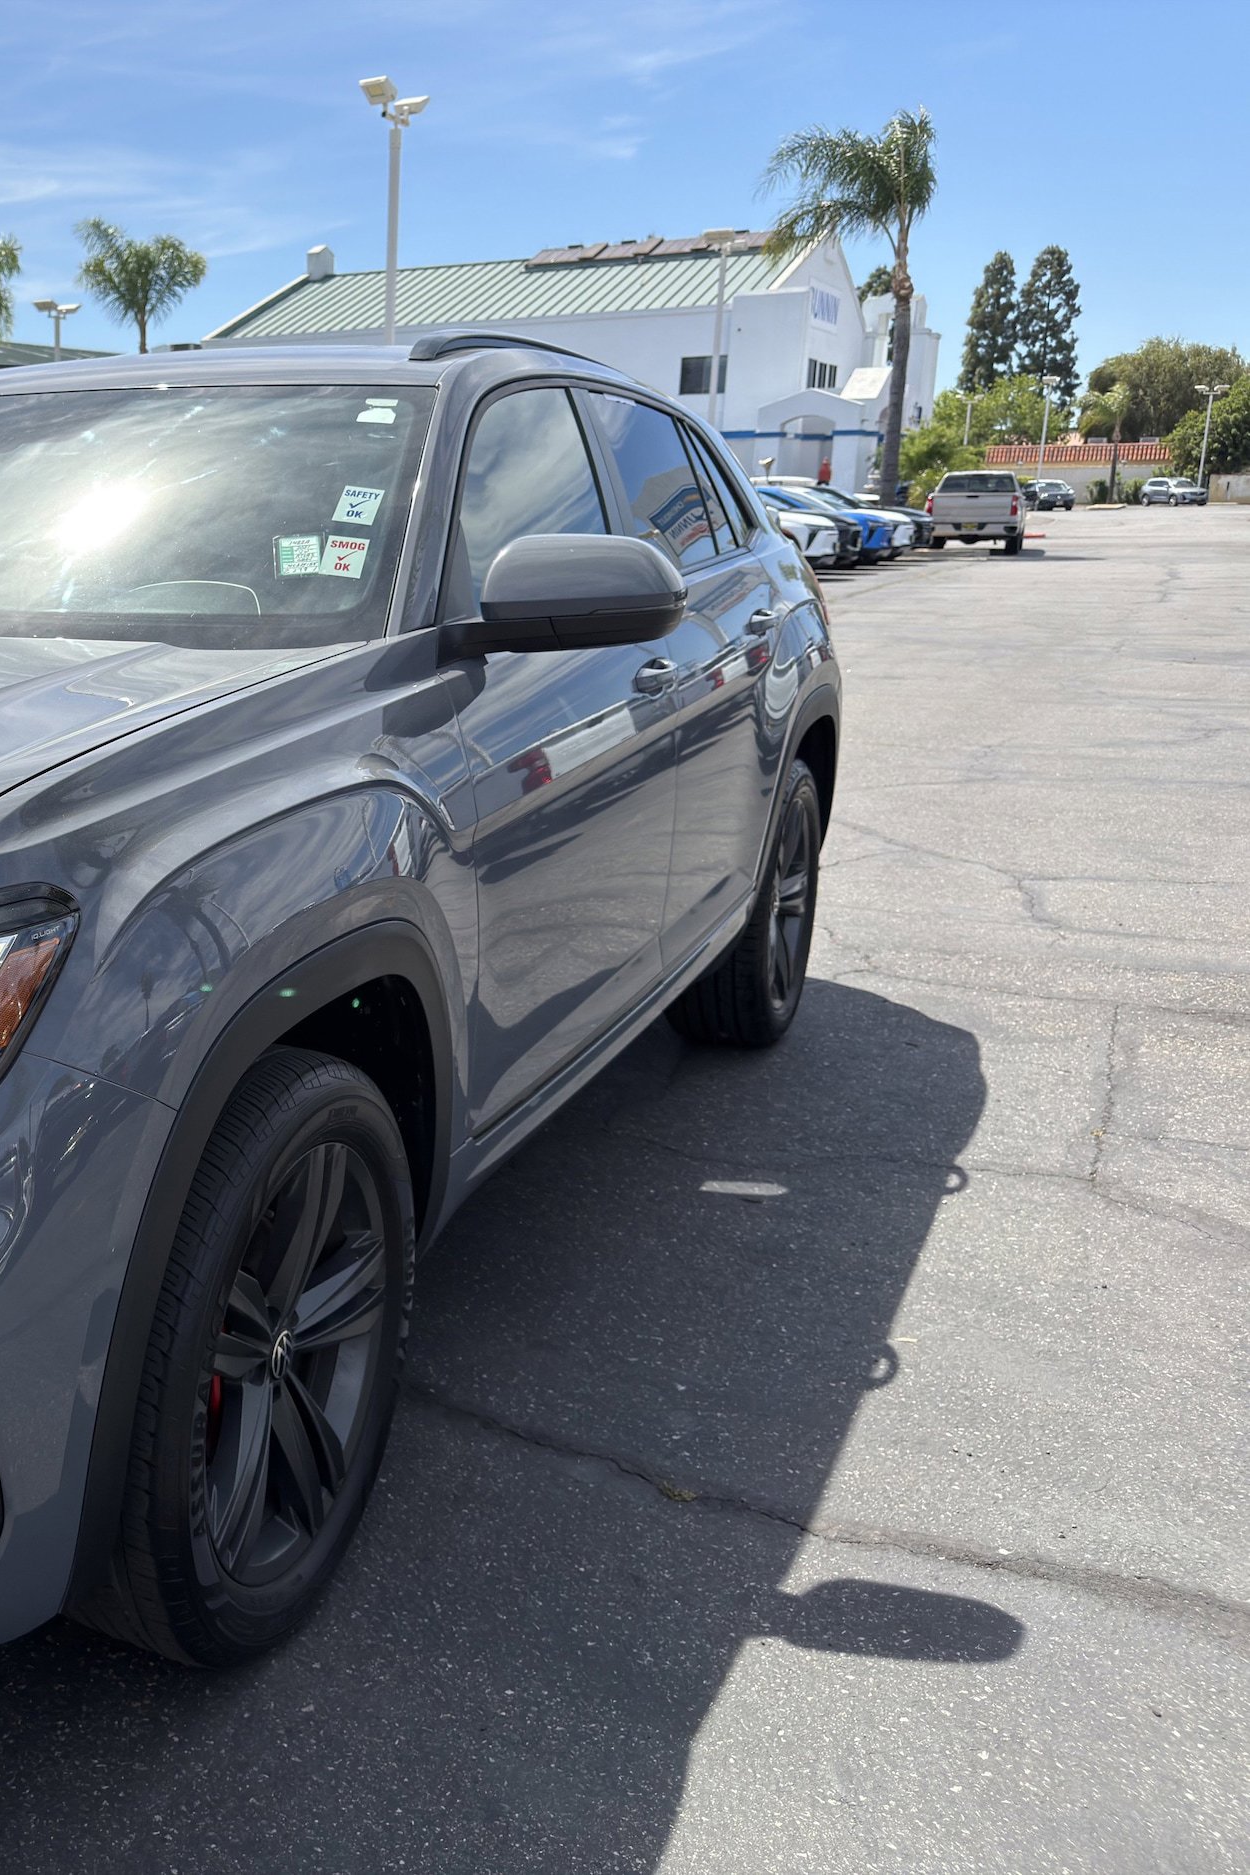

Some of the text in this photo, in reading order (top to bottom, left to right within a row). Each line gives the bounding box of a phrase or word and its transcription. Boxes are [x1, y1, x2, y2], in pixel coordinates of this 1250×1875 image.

[344, 489, 380, 500] SAFETY
[346, 510, 364, 518] OK
[330, 540, 366, 551] SMOG
[334, 562, 351, 572] OK
